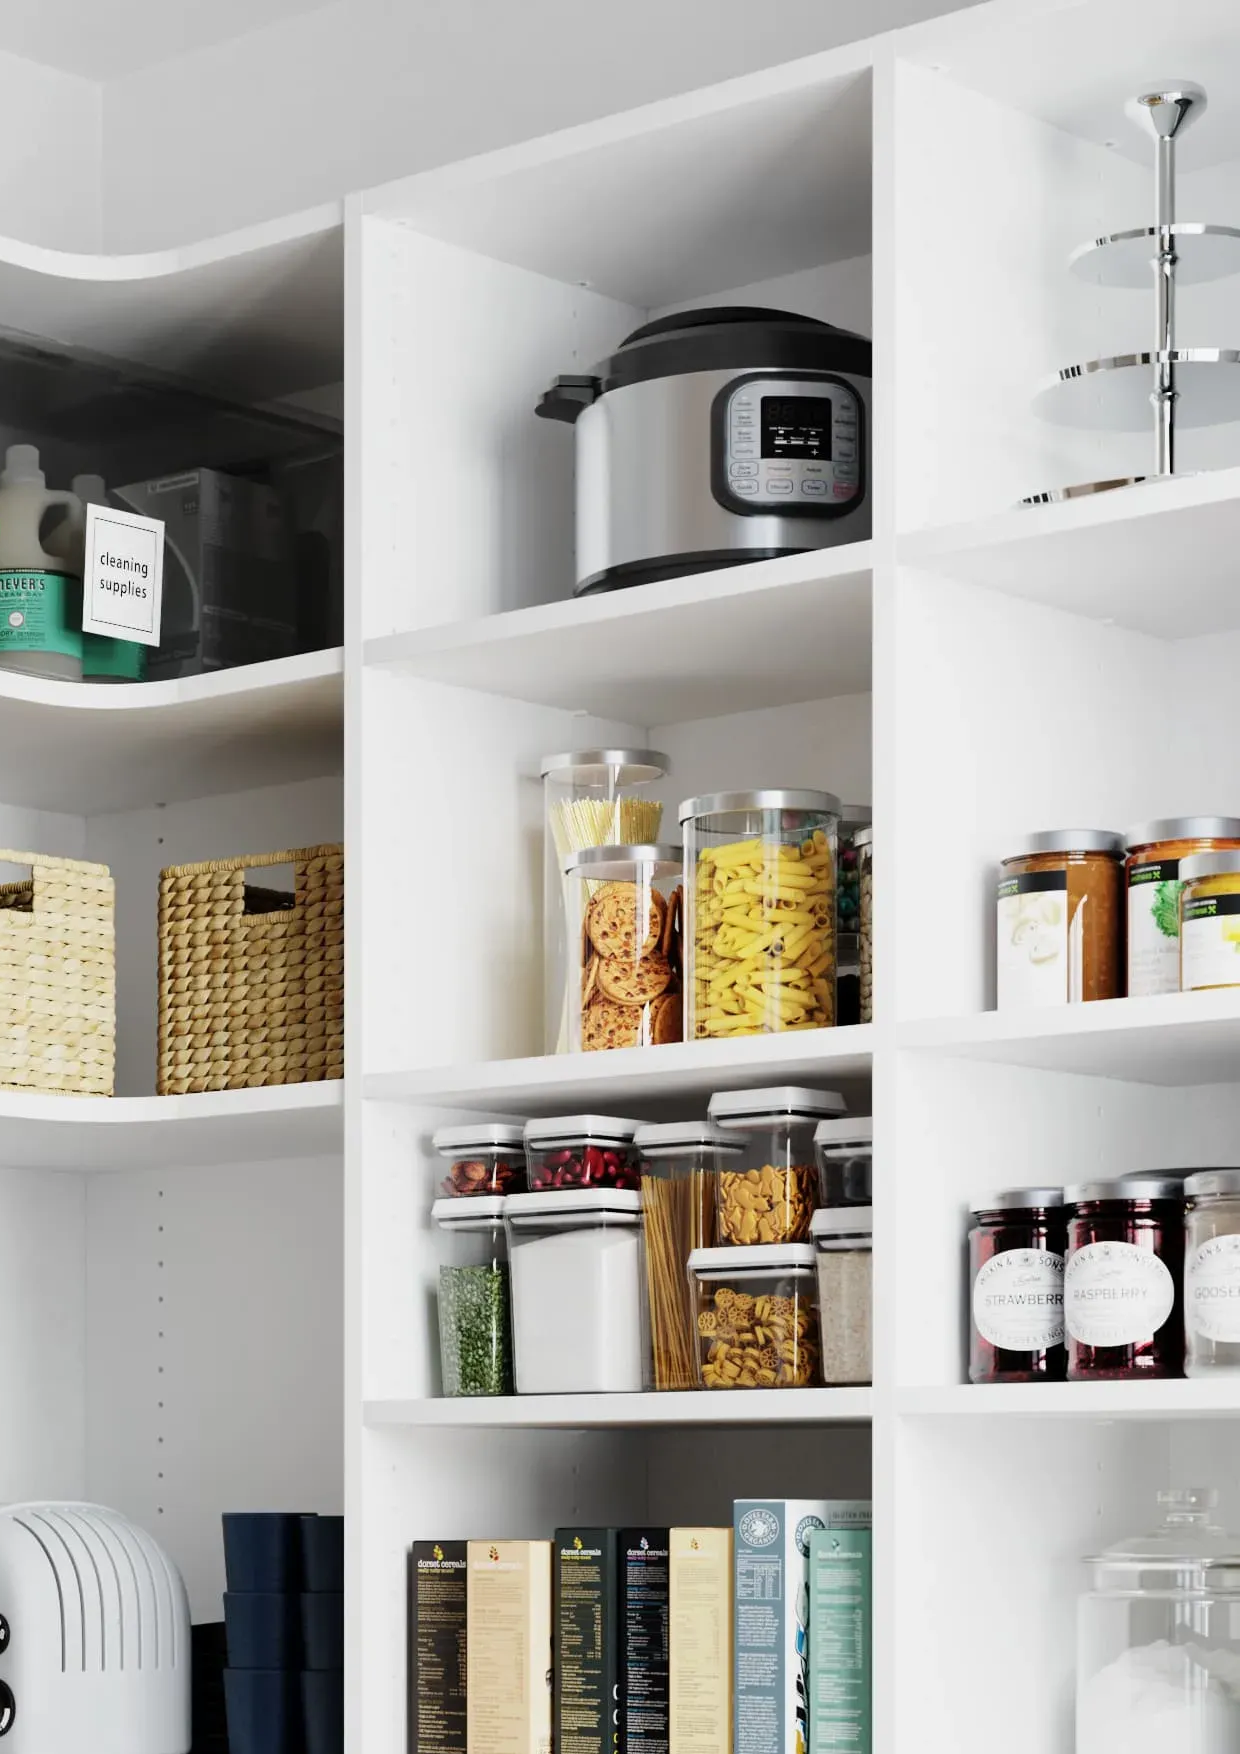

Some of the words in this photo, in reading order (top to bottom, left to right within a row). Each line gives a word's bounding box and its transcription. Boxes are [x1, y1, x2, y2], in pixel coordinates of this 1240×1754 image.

[100, 551, 148, 578] cleaning
[100, 578, 147, 599] supplies
[1039, 1256, 1064, 1274] SONS
[1073, 1287, 1149, 1301] RASPBERRY
[1193, 1285, 1240, 1299] GOOSE
[984, 1293, 1064, 1306] STRAWBERR
[742, 1531, 776, 1546] ORGANIC
[417, 1558, 440, 1568] dorset
[441, 1559, 467, 1569] cereals
